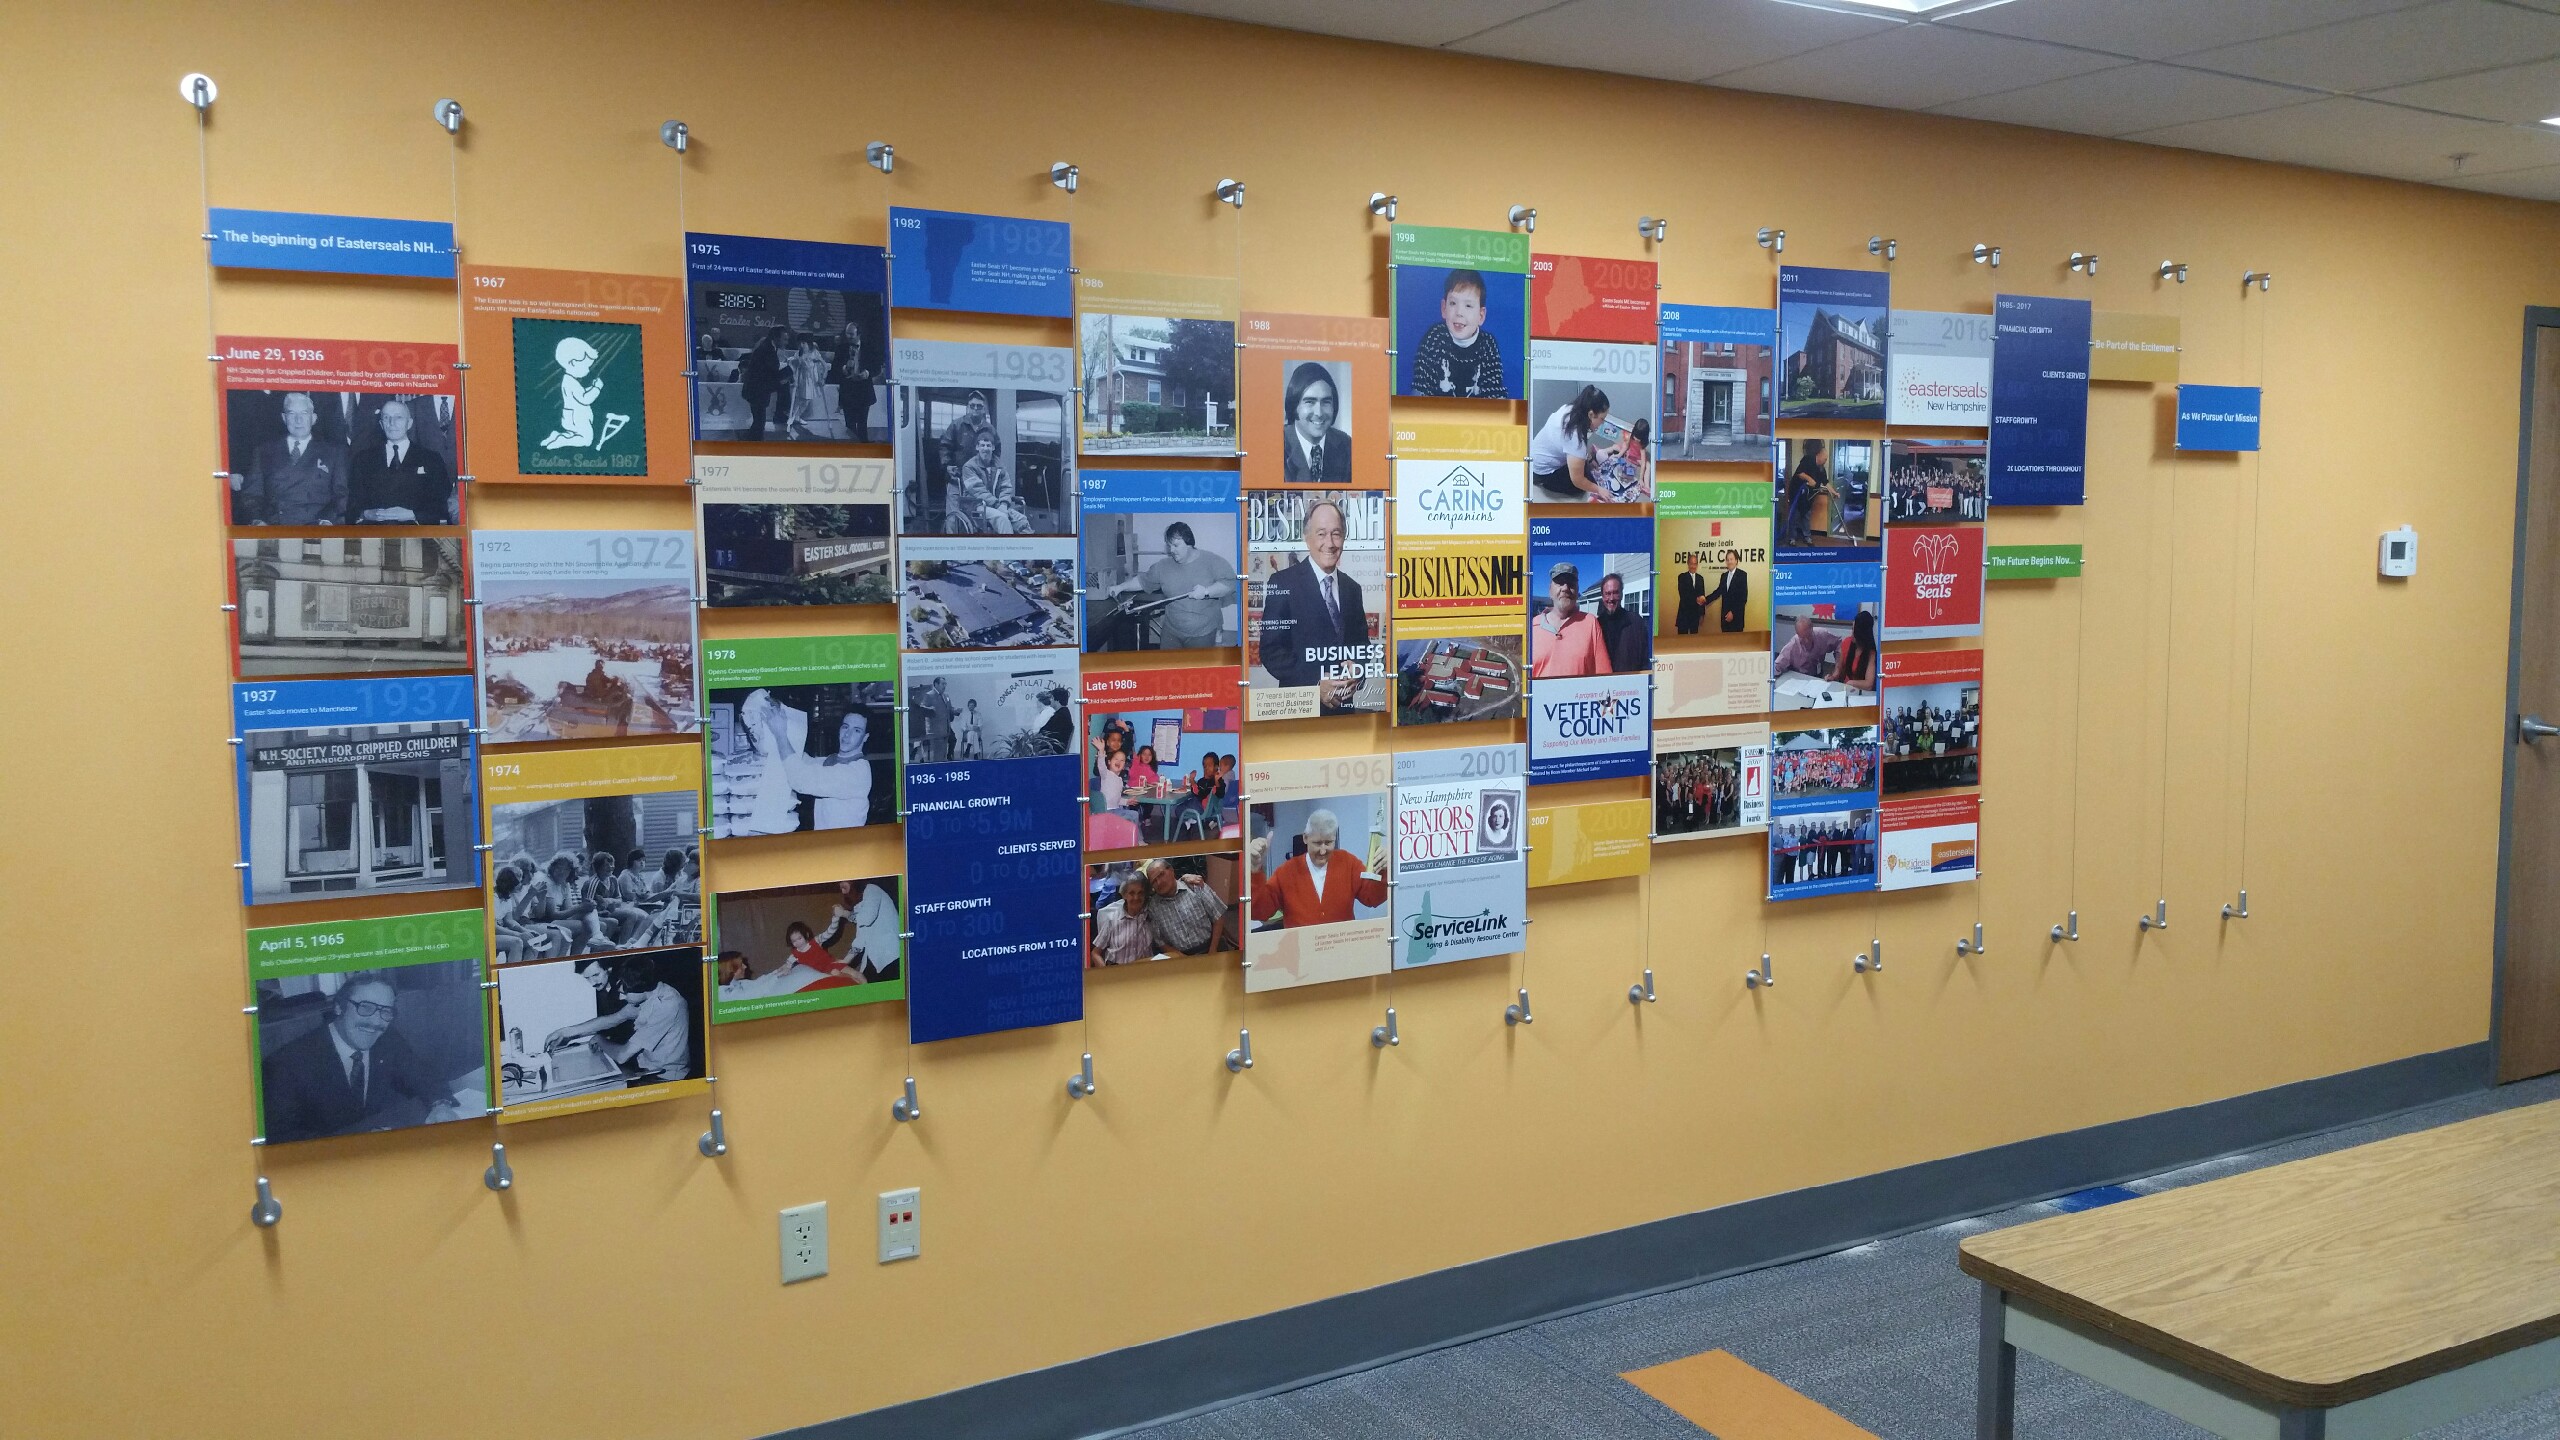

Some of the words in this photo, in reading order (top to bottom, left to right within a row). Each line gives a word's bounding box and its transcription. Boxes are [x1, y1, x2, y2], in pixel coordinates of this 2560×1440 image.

[894, 218, 921, 229] 1982
[223, 230, 248, 243] The
[252, 232, 316, 248] beginning
[321, 235, 334, 247] of
[337, 237, 410, 252] Easterseals
[414, 242, 444, 254] NH...
[1396, 233, 1414, 242] 1998
[691, 244, 720, 255] 1975
[1533, 261, 1553, 271] 2003
[474, 277, 505, 287] 1967
[1080, 278, 1103, 288] 1986
[1782, 274, 1798, 282] 2011
[1663, 311, 1680, 320] 2008
[1249, 320, 1270, 330] 1988
[1999, 325, 2027, 333] FINANCIAL
[2095, 340, 2104, 348] Be
[2106, 340, 2120, 349] Part
[2120, 341, 2127, 349] of
[2129, 341, 2139, 350] the
[2141, 342, 2175, 352] Excitement
[227, 348, 260, 359] June
[264, 349, 285, 361] 29,
[290, 350, 324, 361] 1936
[899, 350, 924, 361] 1983
[1532, 349, 1552, 358] 2005
[986, 351, 1066, 383] 1983
[1593, 348, 1651, 375] 2005
[2066, 371, 2086, 379] SERVED
[1909, 381, 1987, 398] easterseals
[1927, 401, 1944, 411] New
[1947, 401, 1986, 413] Hampshire
[1995, 416, 2013, 424] STAFF
[2201, 413, 2223, 421] Pursue
[2235, 414, 2257, 423] Mission
[1396, 432, 1415, 440] 2000
[702, 467, 729, 477] 1977
[796, 463, 887, 494] 1977
[1082, 479, 1107, 491] 1987
[1419, 489, 1503, 511] CARING
[1532, 526, 1551, 535] 2006
[478, 542, 511, 552] 1972
[804, 545, 834, 562] EASTER
[834, 544, 849, 556] SEAL
[586, 537, 686, 570] 1972
[1992, 557, 2005, 566] The
[2007, 557, 2030, 565] Future
[2031, 556, 2053, 567] Begins
[1776, 571, 1792, 579] 2012
[1914, 572, 1957, 585] Easter
[1916, 584, 1952, 599] Seals
[707, 650, 736, 660] 1978
[1305, 644, 1385, 662] BUSINESS
[1320, 663, 1385, 680] LEADER
[1657, 663, 1673, 672] 2010
[1885, 661, 1901, 670] 2017
[1086, 681, 1107, 691] Late
[1109, 680, 1137, 690] 1980s
[1354, 680, 1385, 701] Year
[242, 690, 277, 702] 1937
[1256, 692, 1265, 700] 27
[1299, 690, 1314, 698] Larry
[1257, 709, 1278, 717] Leader
[1559, 716, 1626, 738] COUNT
[260, 751, 280, 761] N.H.
[281, 747, 327, 760] SOCIETY
[331, 744, 352, 756] FOR
[356, 740, 402, 755] CRIPPLED
[407, 737, 457, 751] CHILDREN
[380, 751, 430, 760] PERSONS
[1397, 760, 1415, 769] 2001
[1459, 749, 1518, 778] 2001
[487, 765, 521, 777] 1974
[1250, 772, 1270, 781] 1996
[910, 774, 935, 784] 1936
[945, 771, 970, 782] 1985
[1400, 793, 1422, 806] New
[1424, 788, 1473, 806] Hampshire
[912, 800, 965, 813] FINANCIAL
[968, 796, 1010, 808] GROWTH
[1400, 805, 1473, 835] SENIORS
[1531, 816, 1549, 825] 2007
[998, 843, 1037, 855] CLIENTS
[1040, 839, 1076, 851] SERVED
[1400, 830, 1473, 861] COUNT
[1938, 847, 1974, 858] easterseals
[1435, 859, 1455, 868] CHANGE
[1488, 854, 1505, 862] AGING
[915, 902, 945, 914] STAFF
[947, 897, 991, 910] GROWTH
[1413, 914, 1507, 941] ServiceLink
[260, 939, 290, 952] April
[295, 937, 307, 948] 5,
[311, 933, 344, 946] 1965
[1451, 936, 1476, 946] Disability
[1477, 934, 1500, 943] Resource
[1503, 931, 1520, 939] Center
[962, 945, 1017, 959] LOCATIONS
[1019, 942, 1046, 954] FROM
[1049, 940, 1054, 948] 1
[1055, 938, 1069, 948] TO
[1071, 938, 1078, 946] 4
